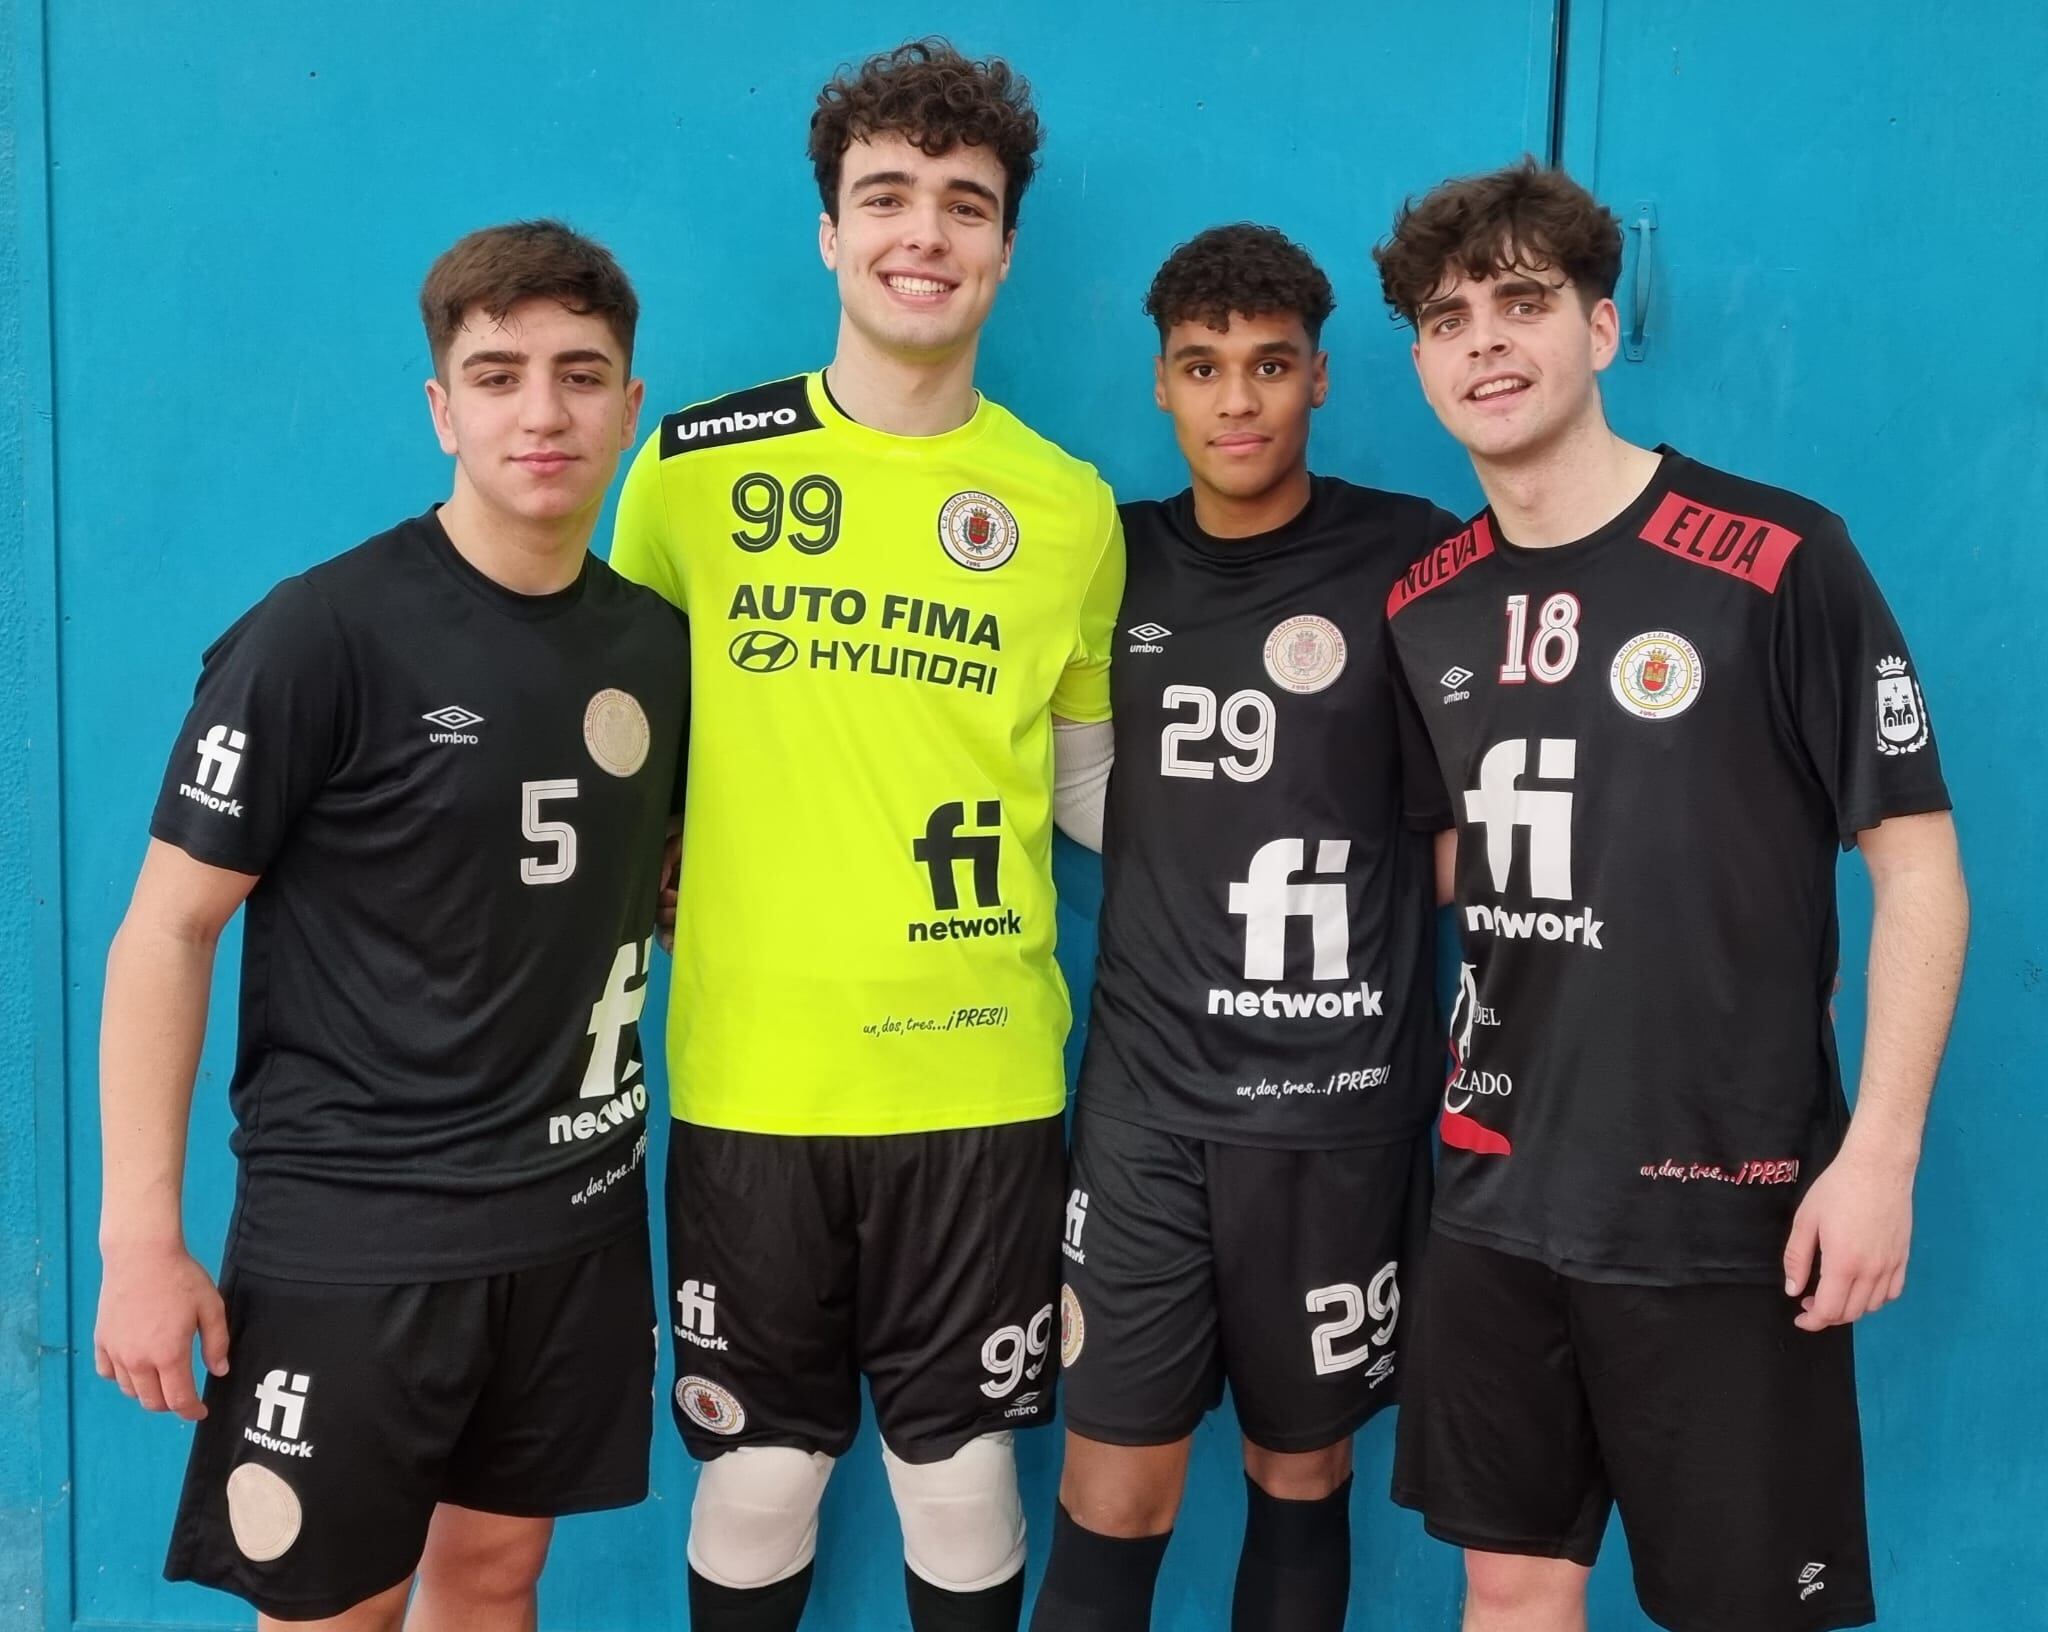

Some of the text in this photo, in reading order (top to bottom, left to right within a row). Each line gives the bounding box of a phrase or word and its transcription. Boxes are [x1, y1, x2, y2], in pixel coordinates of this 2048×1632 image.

[678, 408, 797, 440] umbro
[731, 472, 843, 555] 99
[945, 495, 967, 514] NUEVA
[968, 493, 989, 501] ELDA
[1400, 526, 1477, 600] NUEVA
[1663, 505, 1770, 574] ELDA
[729, 585, 1001, 651] AUTO FIMA
[1270, 621, 1292, 642] NUEVA
[1499, 593, 1582, 685] 18
[810, 639, 998, 695] HYUNDAI
[1130, 642, 1164, 654] umbro
[1618, 636, 1644, 659] NUEVA
[1646, 632, 1670, 640] ELDA
[1672, 636, 1697, 663] FUTBOL
[1691, 664, 1699, 690] SALA
[1444, 690, 1470, 704] umbro
[196, 724, 247, 796] fi
[430, 732, 479, 745] umbro
[1160, 684, 1277, 783] 29
[180, 783, 243, 818] network
[1463, 738, 1577, 901] fi
[520, 778, 579, 885] 5
[913, 800, 1001, 911] fi
[909, 909, 1021, 942] network
[1227, 837, 1352, 981] fi
[1465, 904, 1605, 950] nwork
[1208, 981, 1384, 1019] network
[677, 1279, 716, 1336] fi
[1305, 1261, 1400, 1376] 29
[674, 1325, 729, 1351] network
[979, 1303, 1053, 1399] 99
[254, 1369, 311, 1440] fi
[1004, 1405, 1039, 1418] umbro
[244, 1426, 314, 1458] network
